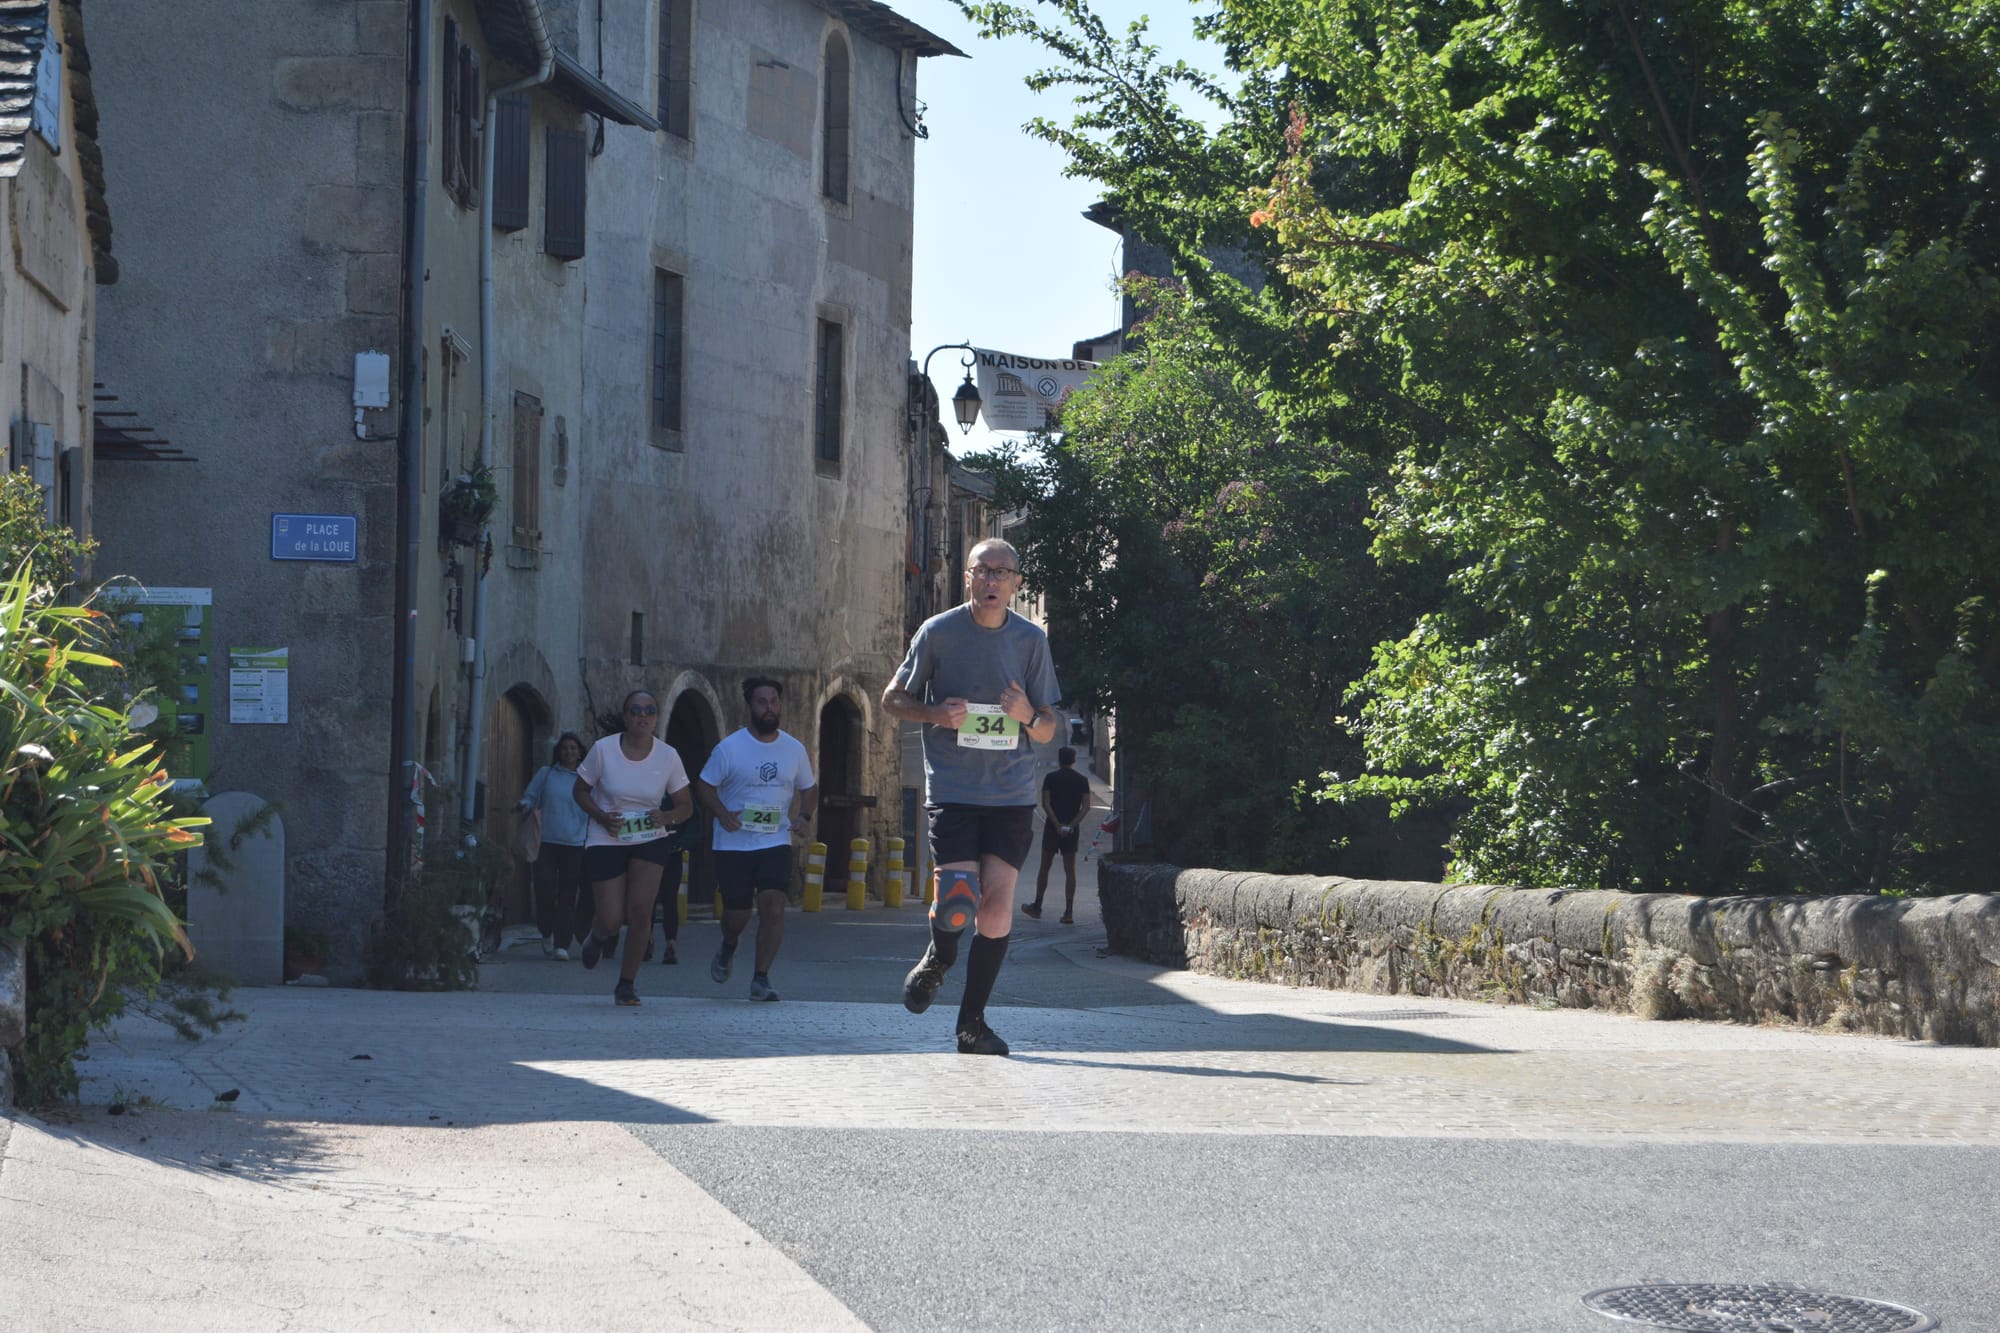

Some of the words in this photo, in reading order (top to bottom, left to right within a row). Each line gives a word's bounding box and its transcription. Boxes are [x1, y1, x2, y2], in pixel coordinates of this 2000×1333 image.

[981, 353, 1058, 370] MAISON
[1062, 360, 1088, 371] DE
[306, 523, 340, 536] PLACE
[295, 540, 307, 551] de
[310, 540, 320, 551] la
[323, 541, 350, 552] LOUE
[975, 716, 1005, 735] 34
[623, 815, 653, 833] 119
[753, 811, 772, 824] 24
